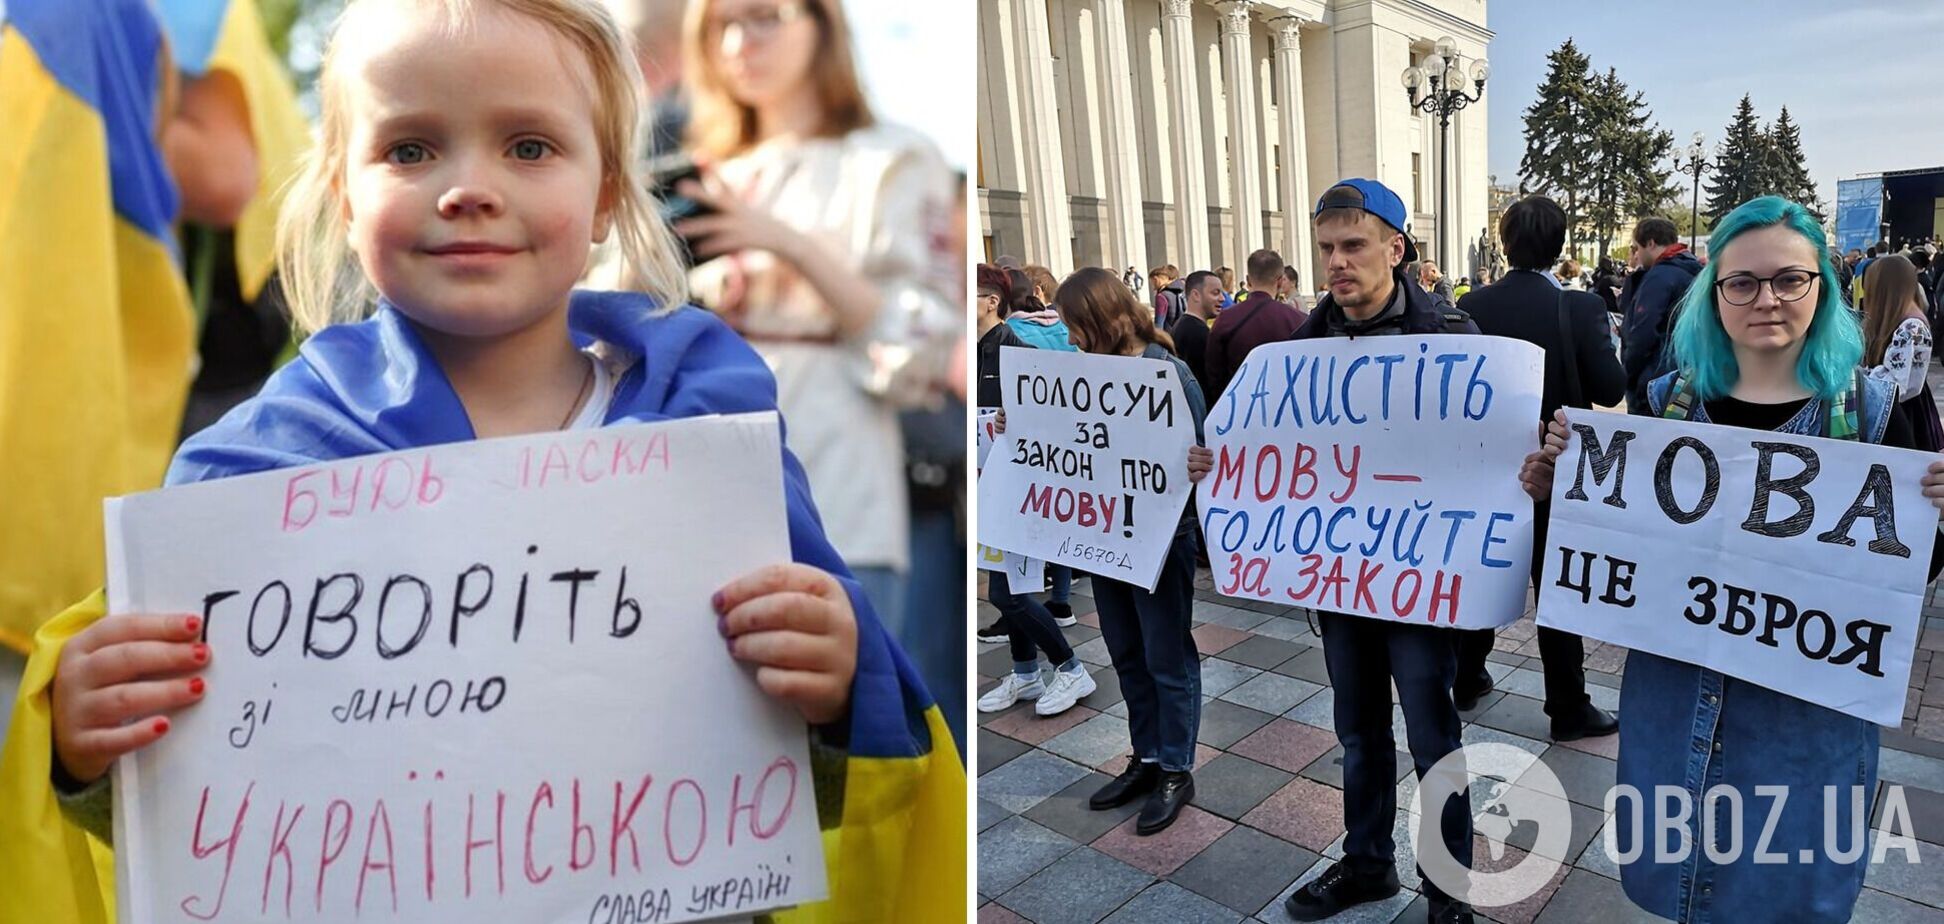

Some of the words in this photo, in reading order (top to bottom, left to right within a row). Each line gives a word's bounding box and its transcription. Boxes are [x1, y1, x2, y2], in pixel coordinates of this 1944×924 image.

[1017, 370, 1174, 428] ГОЛОСУЙ
[1216, 342, 1493, 436] ЗАХИСТІТЬ
[281, 454, 445, 532] БУДЬ
[1020, 482, 1135, 539] МОВУ!
[1564, 423, 1911, 559] МОВА
[1203, 499, 1515, 568] ГОЛОСУЙТЕ
[201, 545, 642, 660] ГОВОРІТЬ
[1286, 554, 1463, 625] ЗАКОН
[1555, 546, 1637, 608] ЦЕ
[1683, 575, 1892, 678] ЗБРОЯ
[181, 755, 798, 921] УКРАЇНСЬКОЮ
[589, 889, 672, 924] СЛАВА
[686, 855, 792, 914] УКРАЇНІ
